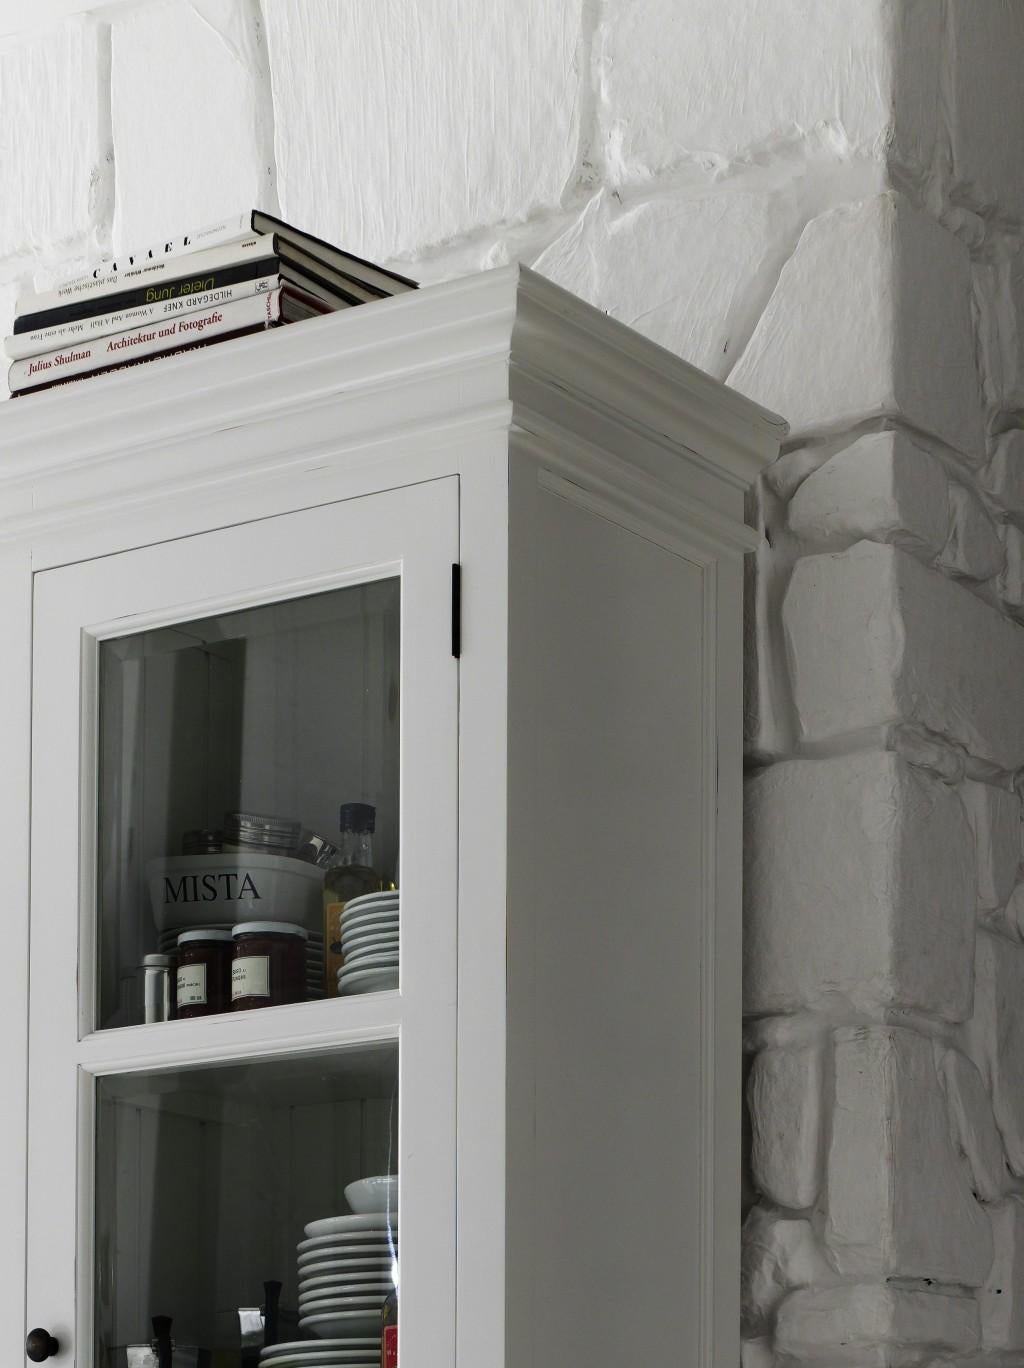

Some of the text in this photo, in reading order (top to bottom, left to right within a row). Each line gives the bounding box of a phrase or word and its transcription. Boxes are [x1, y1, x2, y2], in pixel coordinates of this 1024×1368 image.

[145, 277, 215, 302] Dieter Jung
[186, 289, 232, 307] HILDEGARD
[163, 302, 183, 313] KNEF
[27, 361, 52, 376] Julius
[53, 349, 92, 367] Shulman
[106, 331, 156, 352] Architektur
[158, 325, 176, 337] und
[178, 311, 223, 333] Fotografie
[163, 872, 263, 904] MISTA
